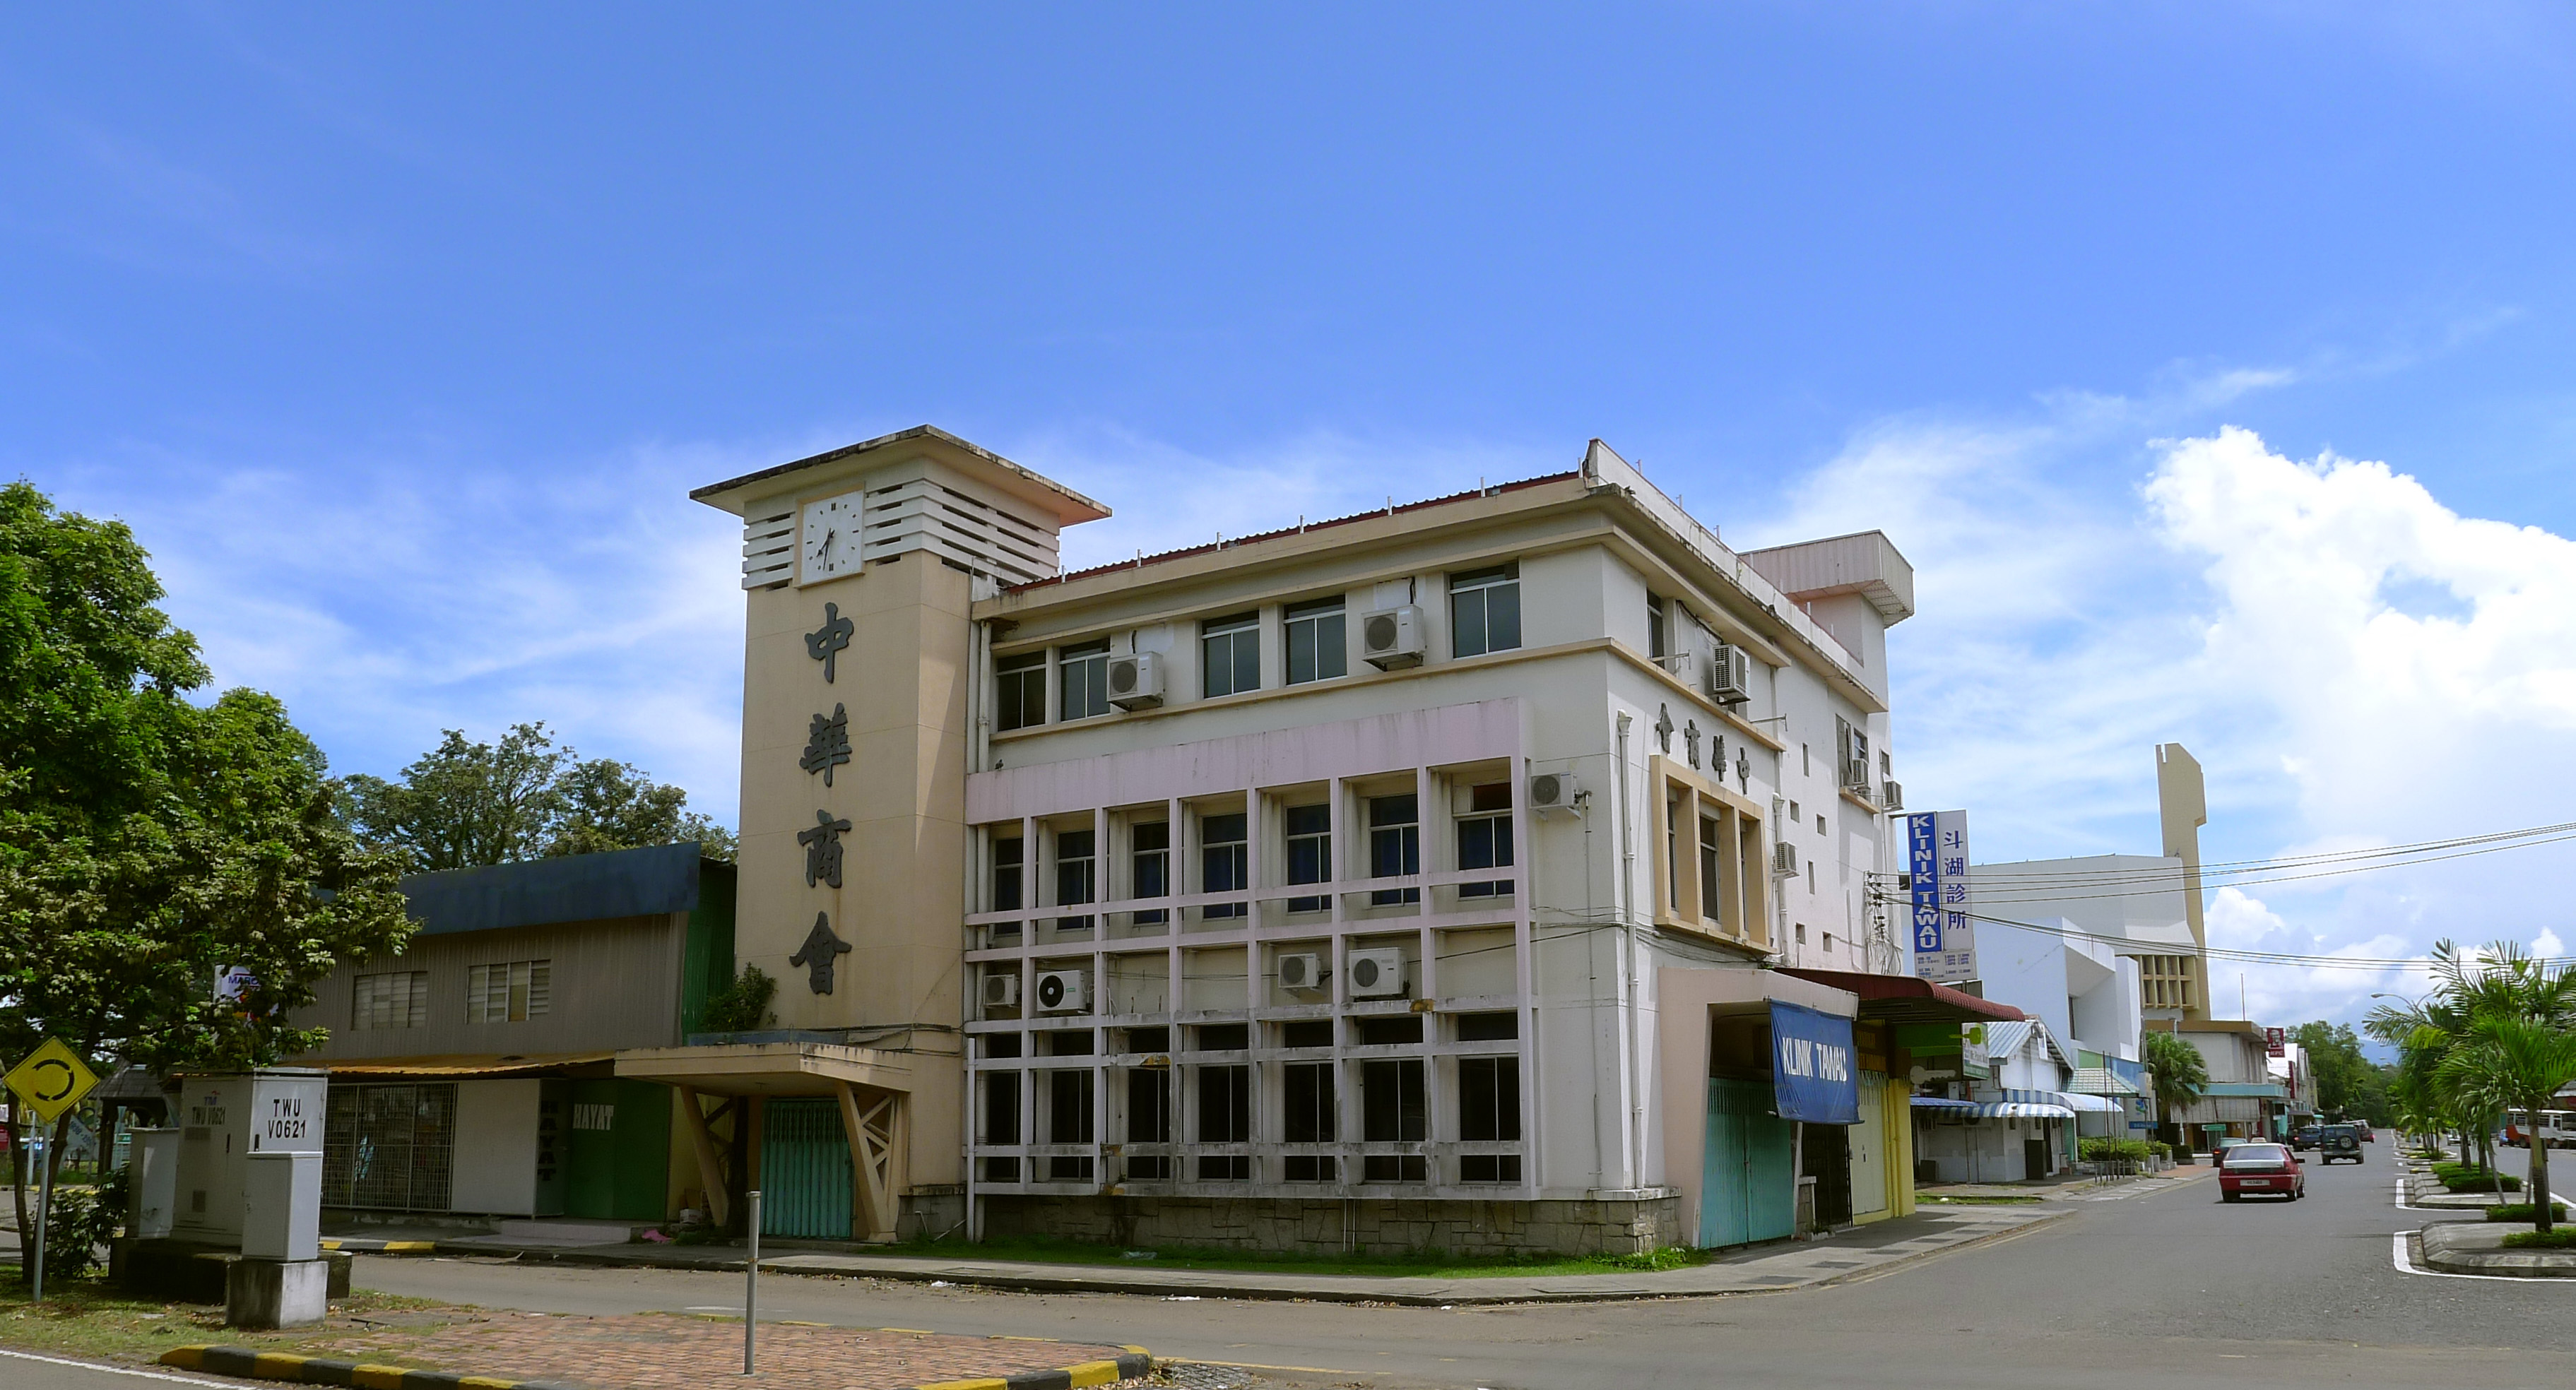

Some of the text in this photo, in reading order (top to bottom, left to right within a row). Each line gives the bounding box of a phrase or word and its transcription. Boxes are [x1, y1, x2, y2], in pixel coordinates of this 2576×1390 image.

[789, 602, 853, 996] 中華商會
[1912, 815, 1939, 949] KLINIK TAWAU
[1944, 830, 1966, 930] 斗湖診所
[1783, 1037, 1814, 1078] KLINIK
[1816, 1042, 1848, 1083] TAWAU
[268, 1119, 306, 1139] V0621
[273, 1098, 301, 1117] TWU
[572, 1103, 615, 1131] HAYAT
[537, 1101, 559, 1181] HAYAT
